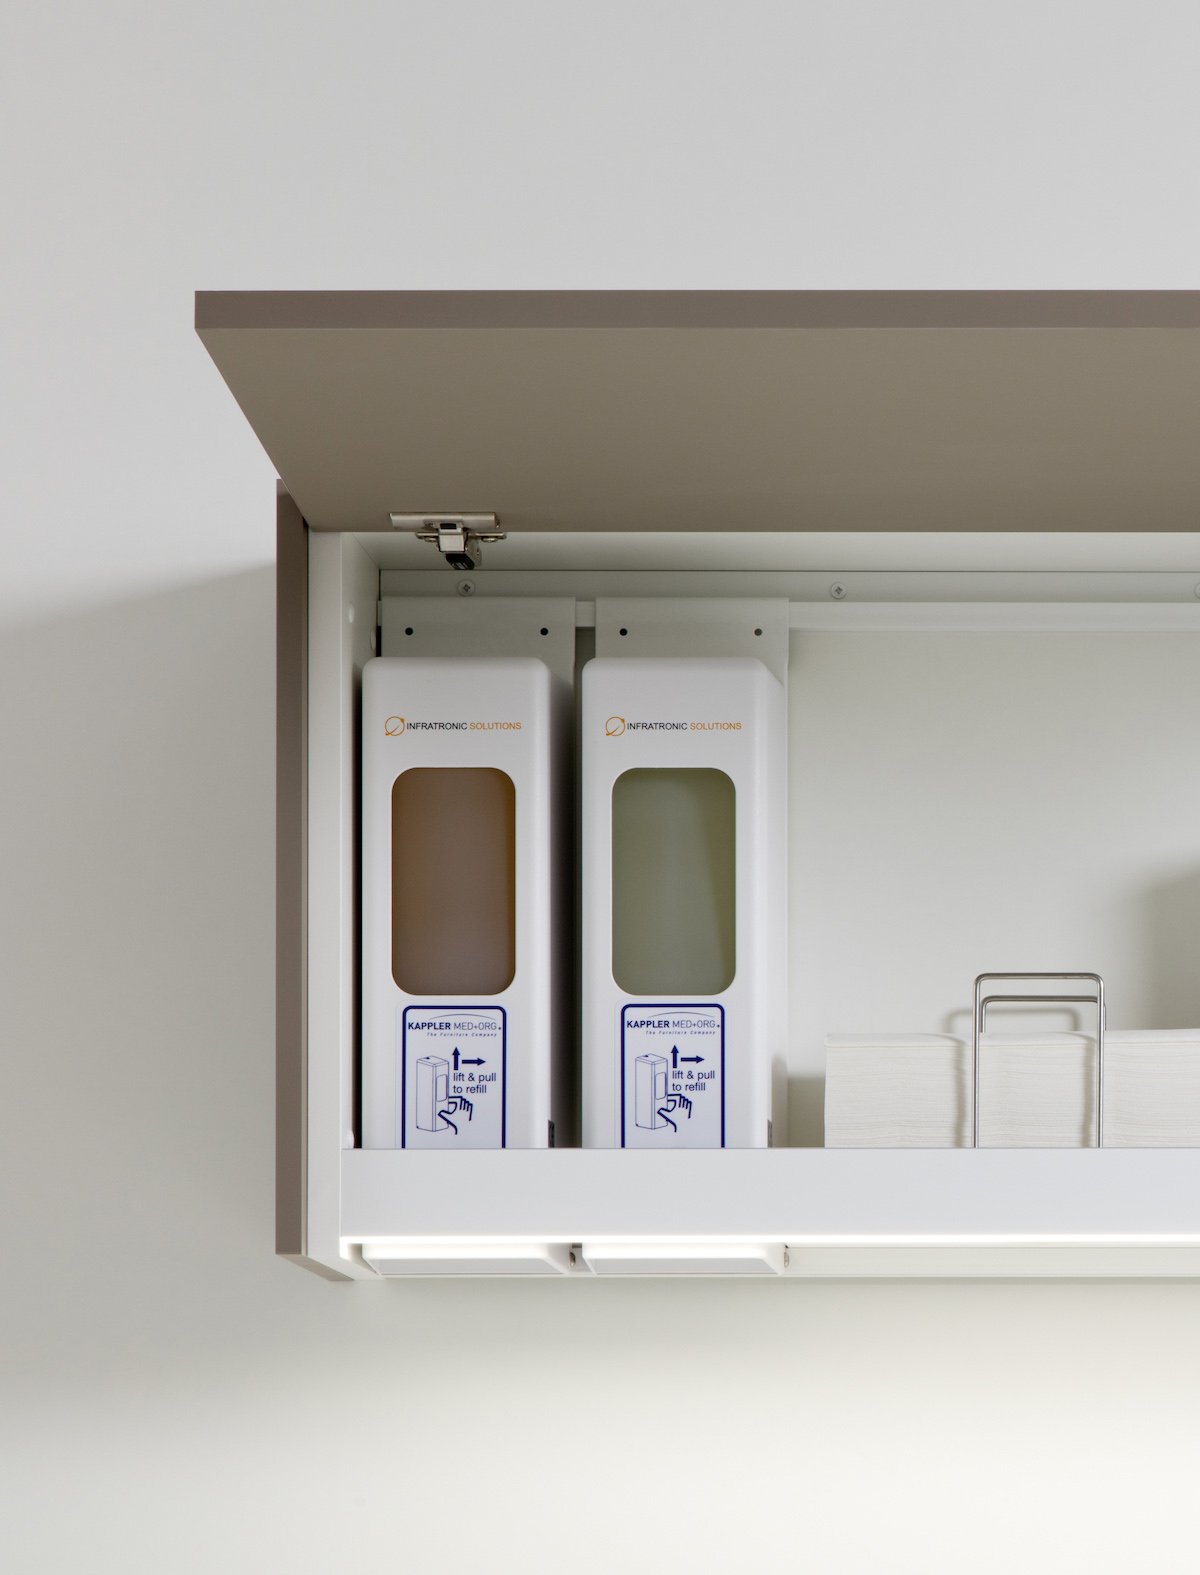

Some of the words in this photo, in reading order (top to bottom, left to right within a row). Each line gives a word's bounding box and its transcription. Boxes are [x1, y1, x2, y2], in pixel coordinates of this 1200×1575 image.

[406, 722, 468, 730] INFRATRONIC
[469, 722, 522, 730] SOLUTIONS
[626, 722, 688, 730] INFRATRONIC
[689, 722, 742, 730] SOLUTIONS
[408, 1022, 451, 1030] KAPPLER
[627, 1020, 670, 1028] KAPPLER
[453, 1073, 465, 1082] lift
[467, 1073, 475, 1082] &
[478, 1073, 497, 1084] pull
[672, 1071, 684, 1080] lift
[686, 1071, 694, 1080] &
[697, 1071, 716, 1082] pull
[453, 1085, 463, 1094] to
[466, 1085, 487, 1094] refill
[672, 1083, 682, 1092] to
[685, 1083, 706, 1092] refill
